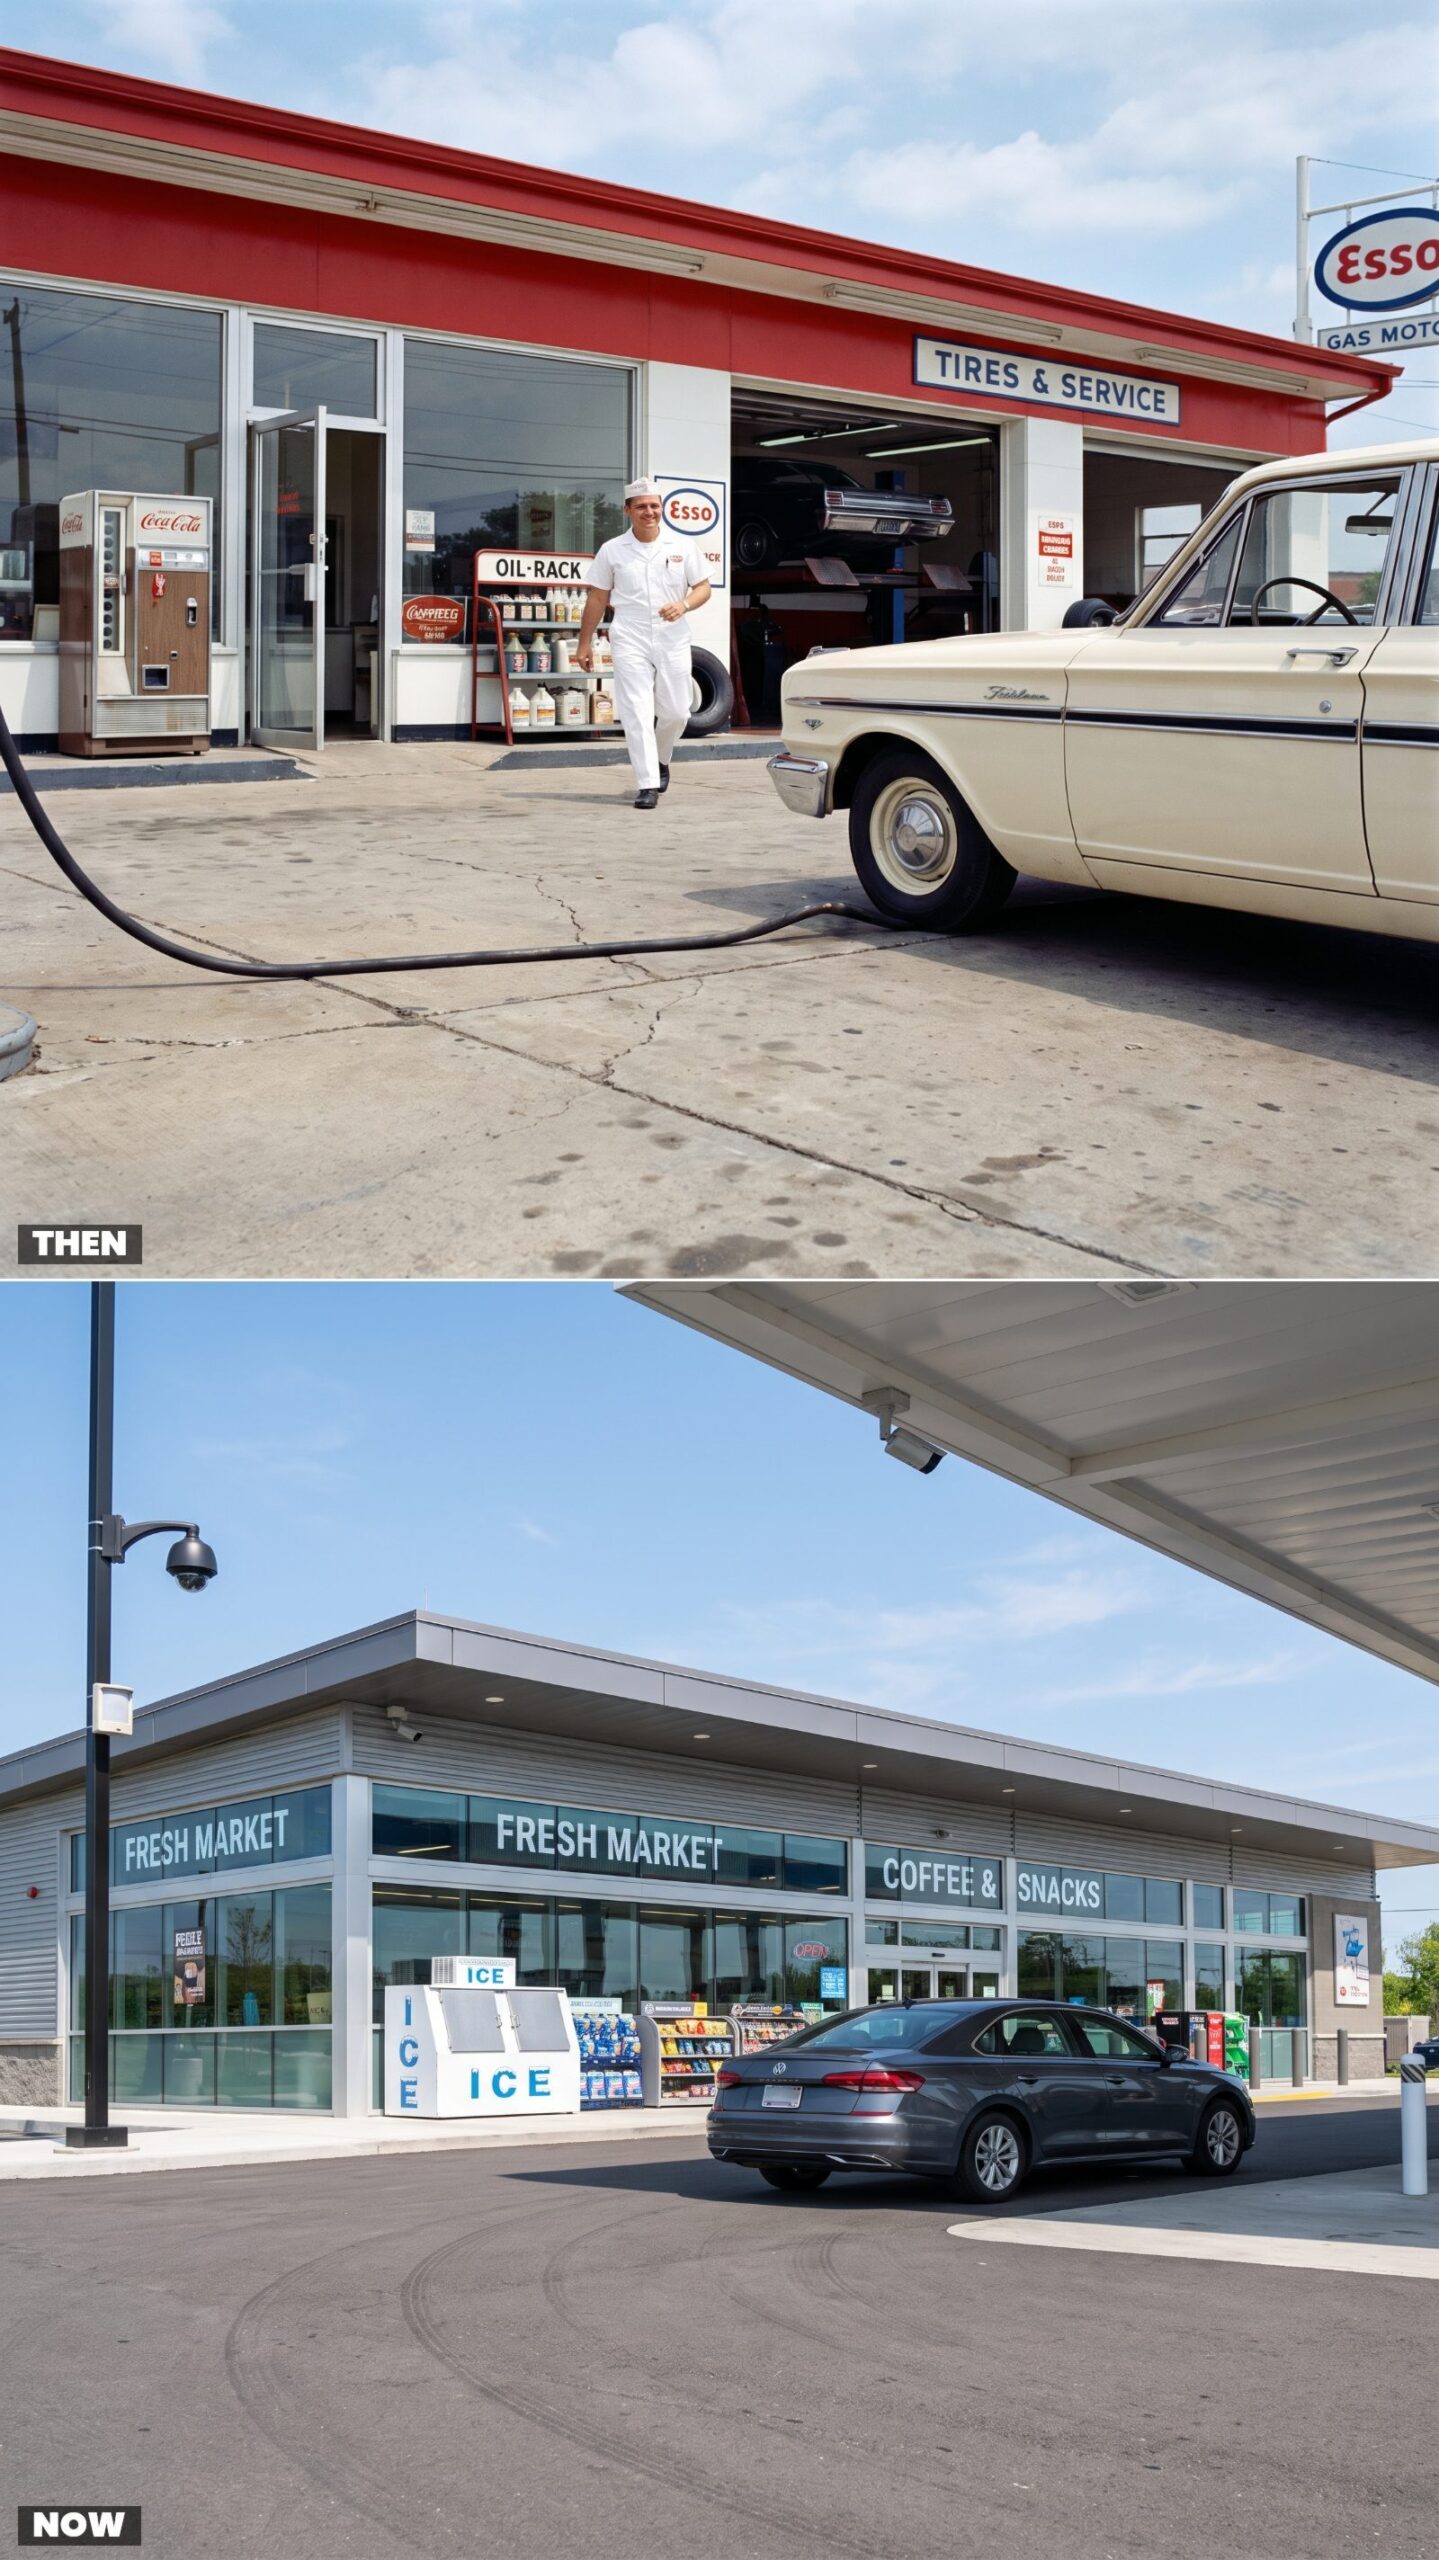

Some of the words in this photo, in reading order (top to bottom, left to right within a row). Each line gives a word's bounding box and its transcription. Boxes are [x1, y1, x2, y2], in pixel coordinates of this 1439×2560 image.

[1327, 330, 1371, 350] GAS
[935, 350, 1020, 388] TIRES
[1033, 368, 1050, 394] &
[1061, 373, 1166, 414] SERVICE
[125, 1828, 189, 1872] FRESH
[195, 1808, 289, 1861] MARKET
[497, 1813, 597, 1859] FRESH
[607, 1826, 723, 1871] MARKET
[883, 1856, 974, 1897] COFFEE
[981, 1869, 997, 1898] &
[1018, 1872, 1100, 1909] SNACKS
[796, 1944, 827, 1959] OPEN
[467, 1967, 504, 1984] ICE
[470, 2066, 551, 2099] ICE
